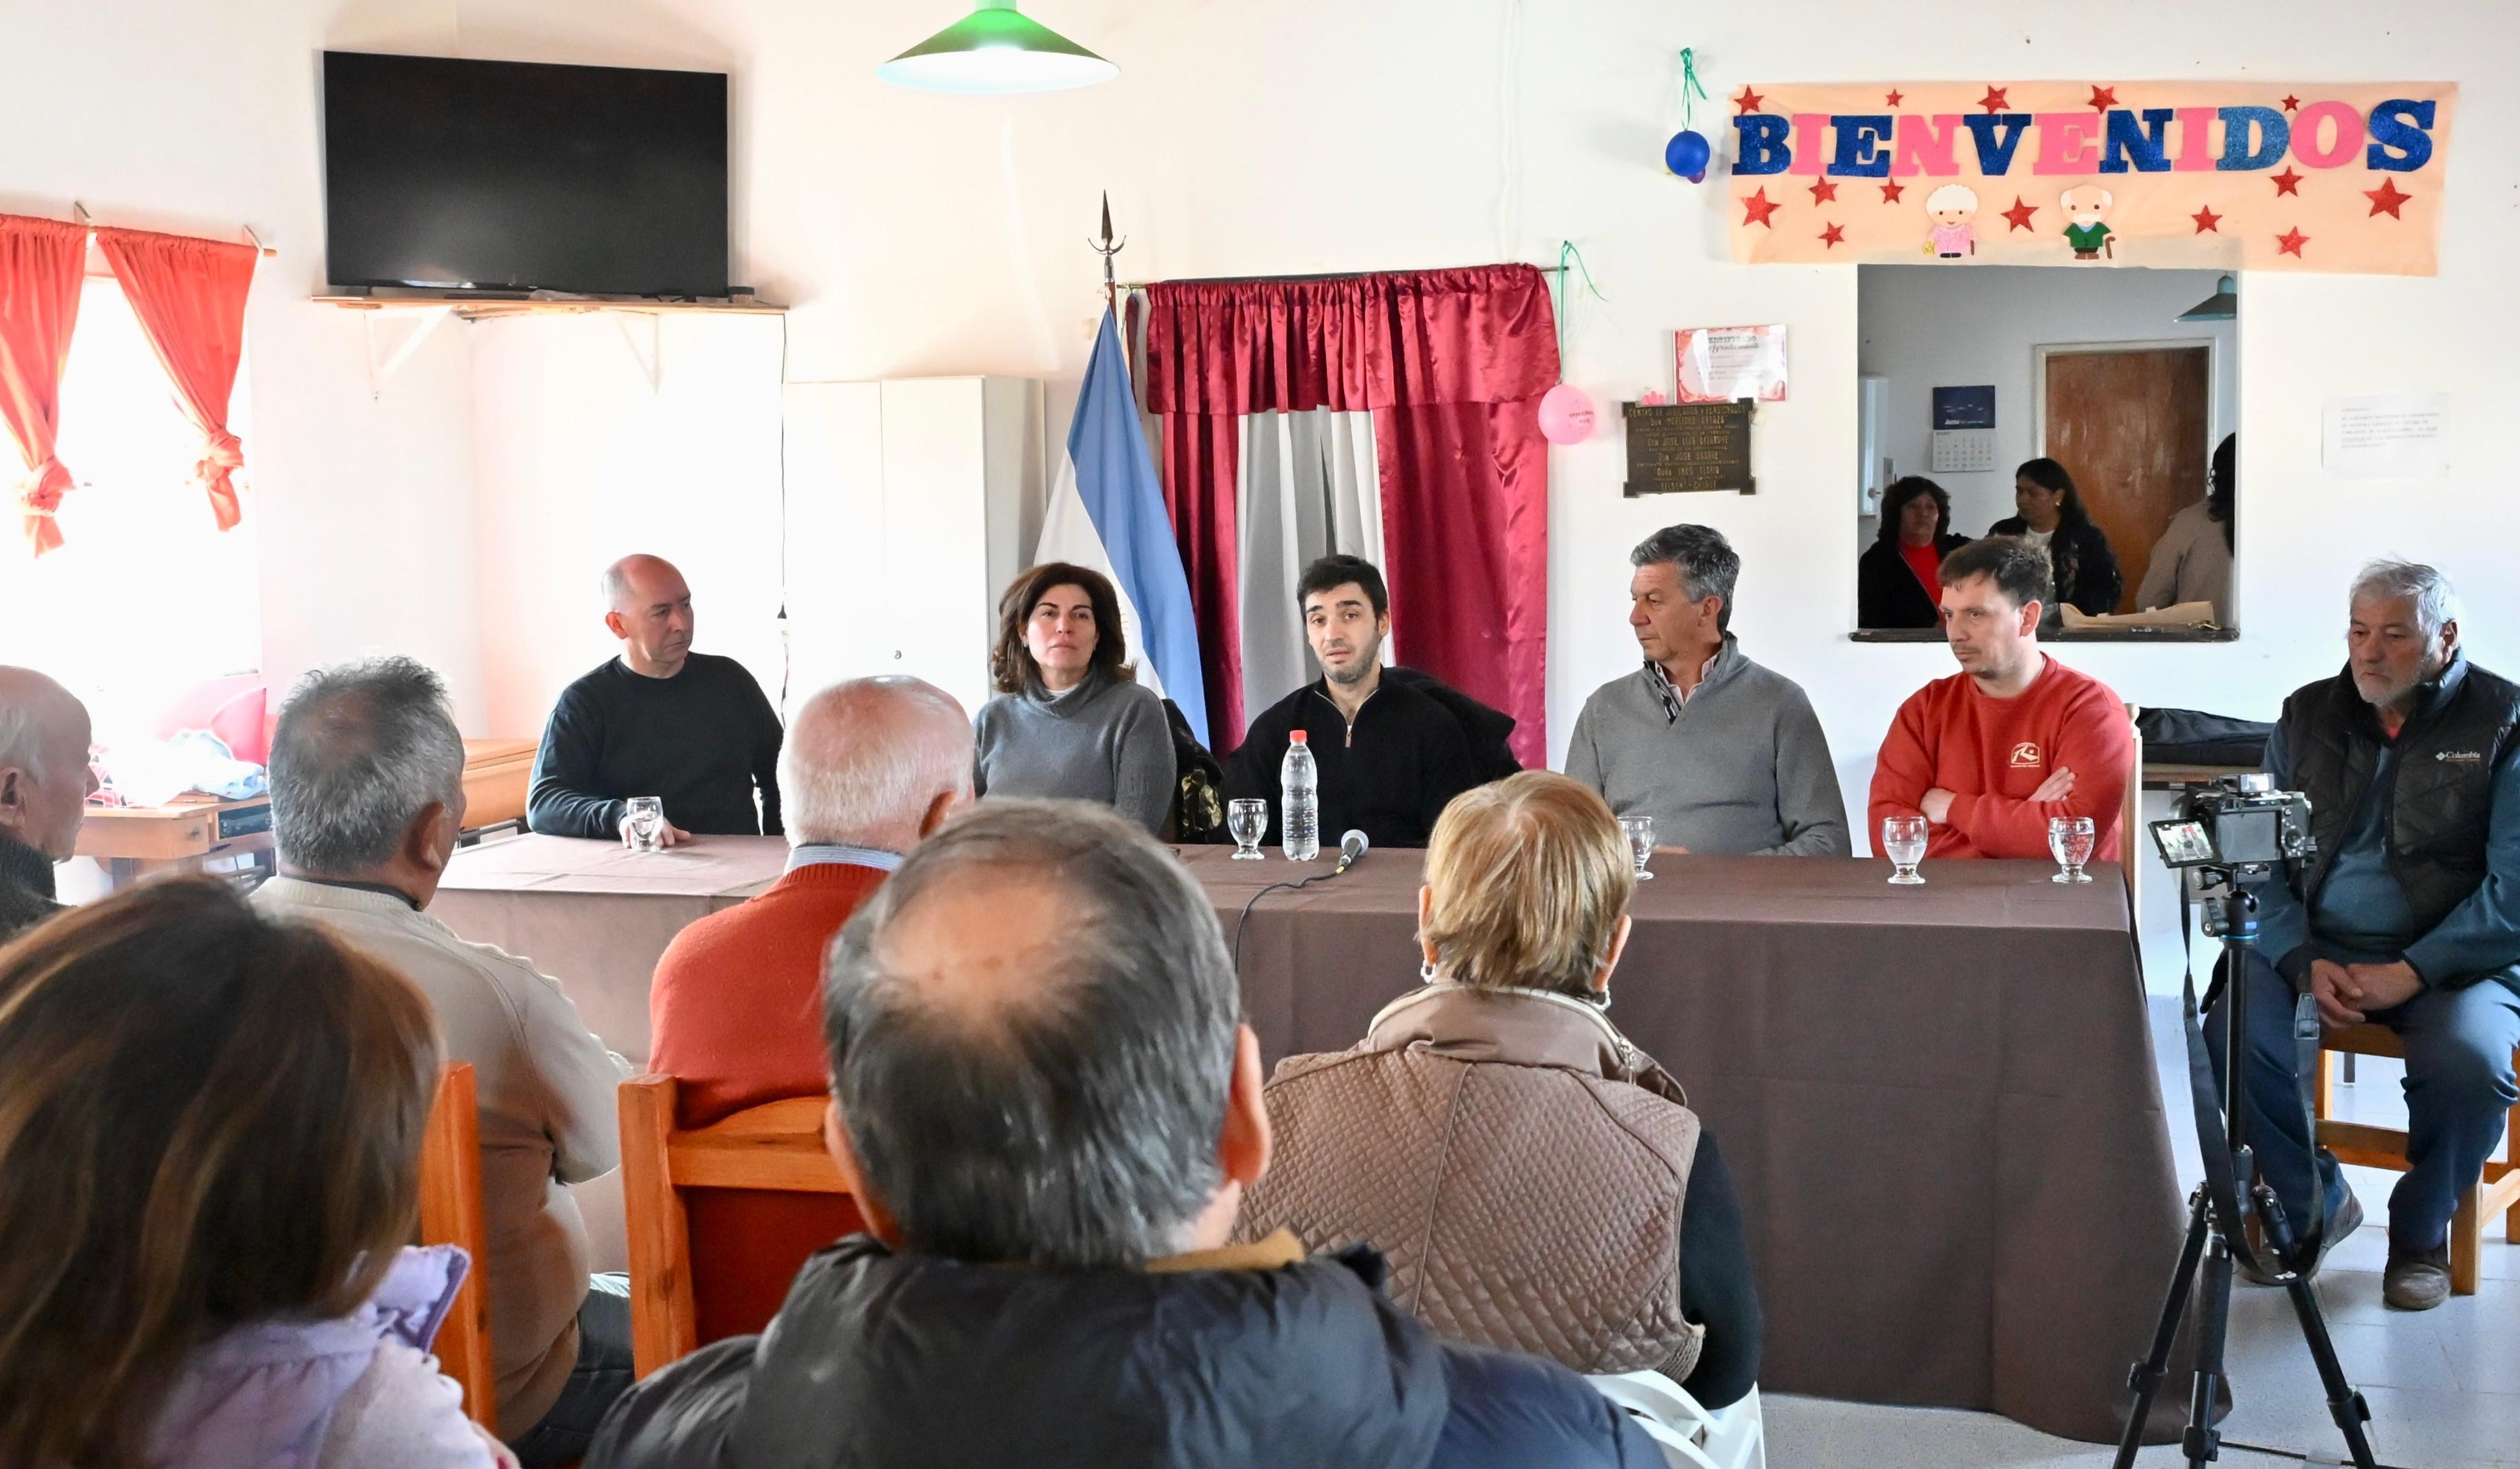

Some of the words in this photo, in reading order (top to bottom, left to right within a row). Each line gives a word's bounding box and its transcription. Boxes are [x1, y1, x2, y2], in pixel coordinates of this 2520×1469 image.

[1732, 99, 2436, 177] BIENVENIDOS
[1629, 408, 1652, 417] CENTRO
[1676, 452, 1691, 461] JOSE
